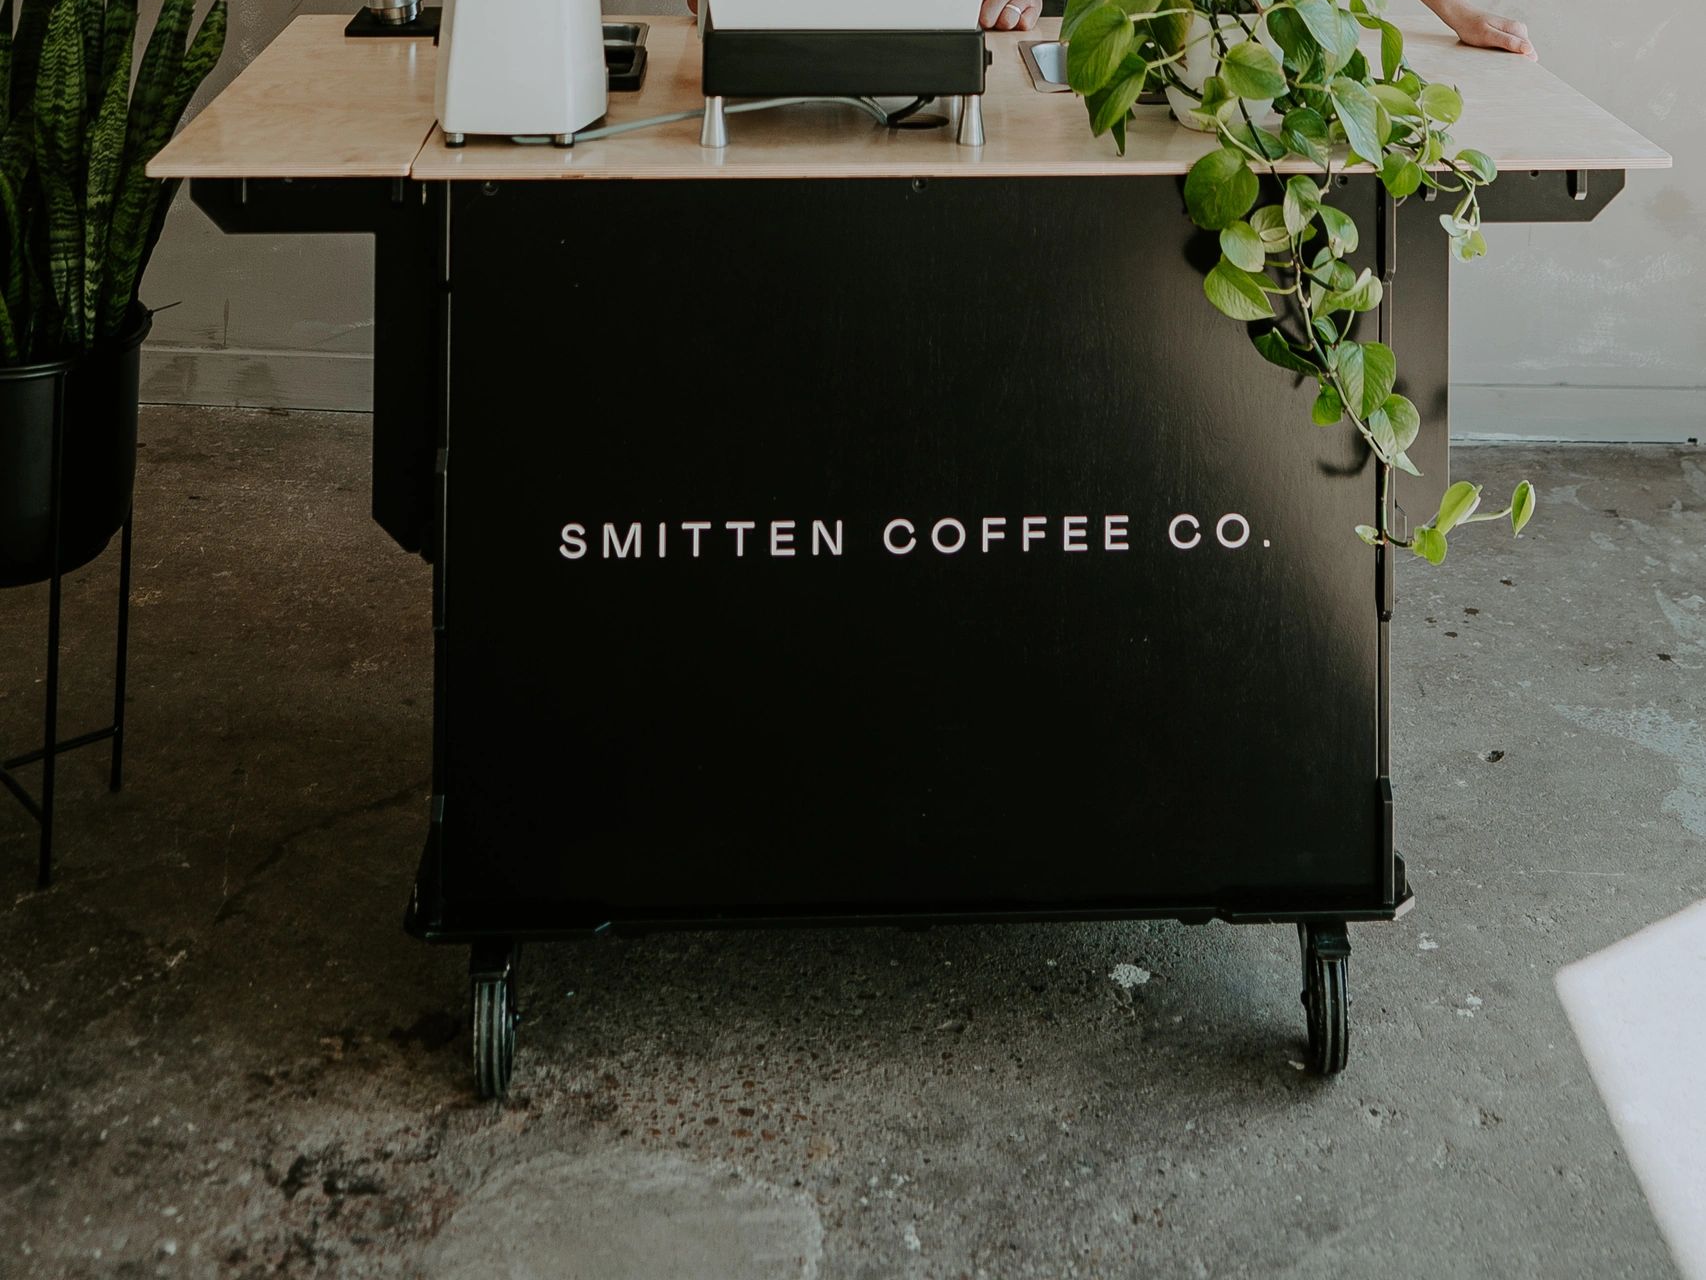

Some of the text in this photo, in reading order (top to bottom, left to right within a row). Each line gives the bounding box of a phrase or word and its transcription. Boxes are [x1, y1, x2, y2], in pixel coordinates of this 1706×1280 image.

[559, 512, 1271, 560] SMITTEN COFFEE CO.
